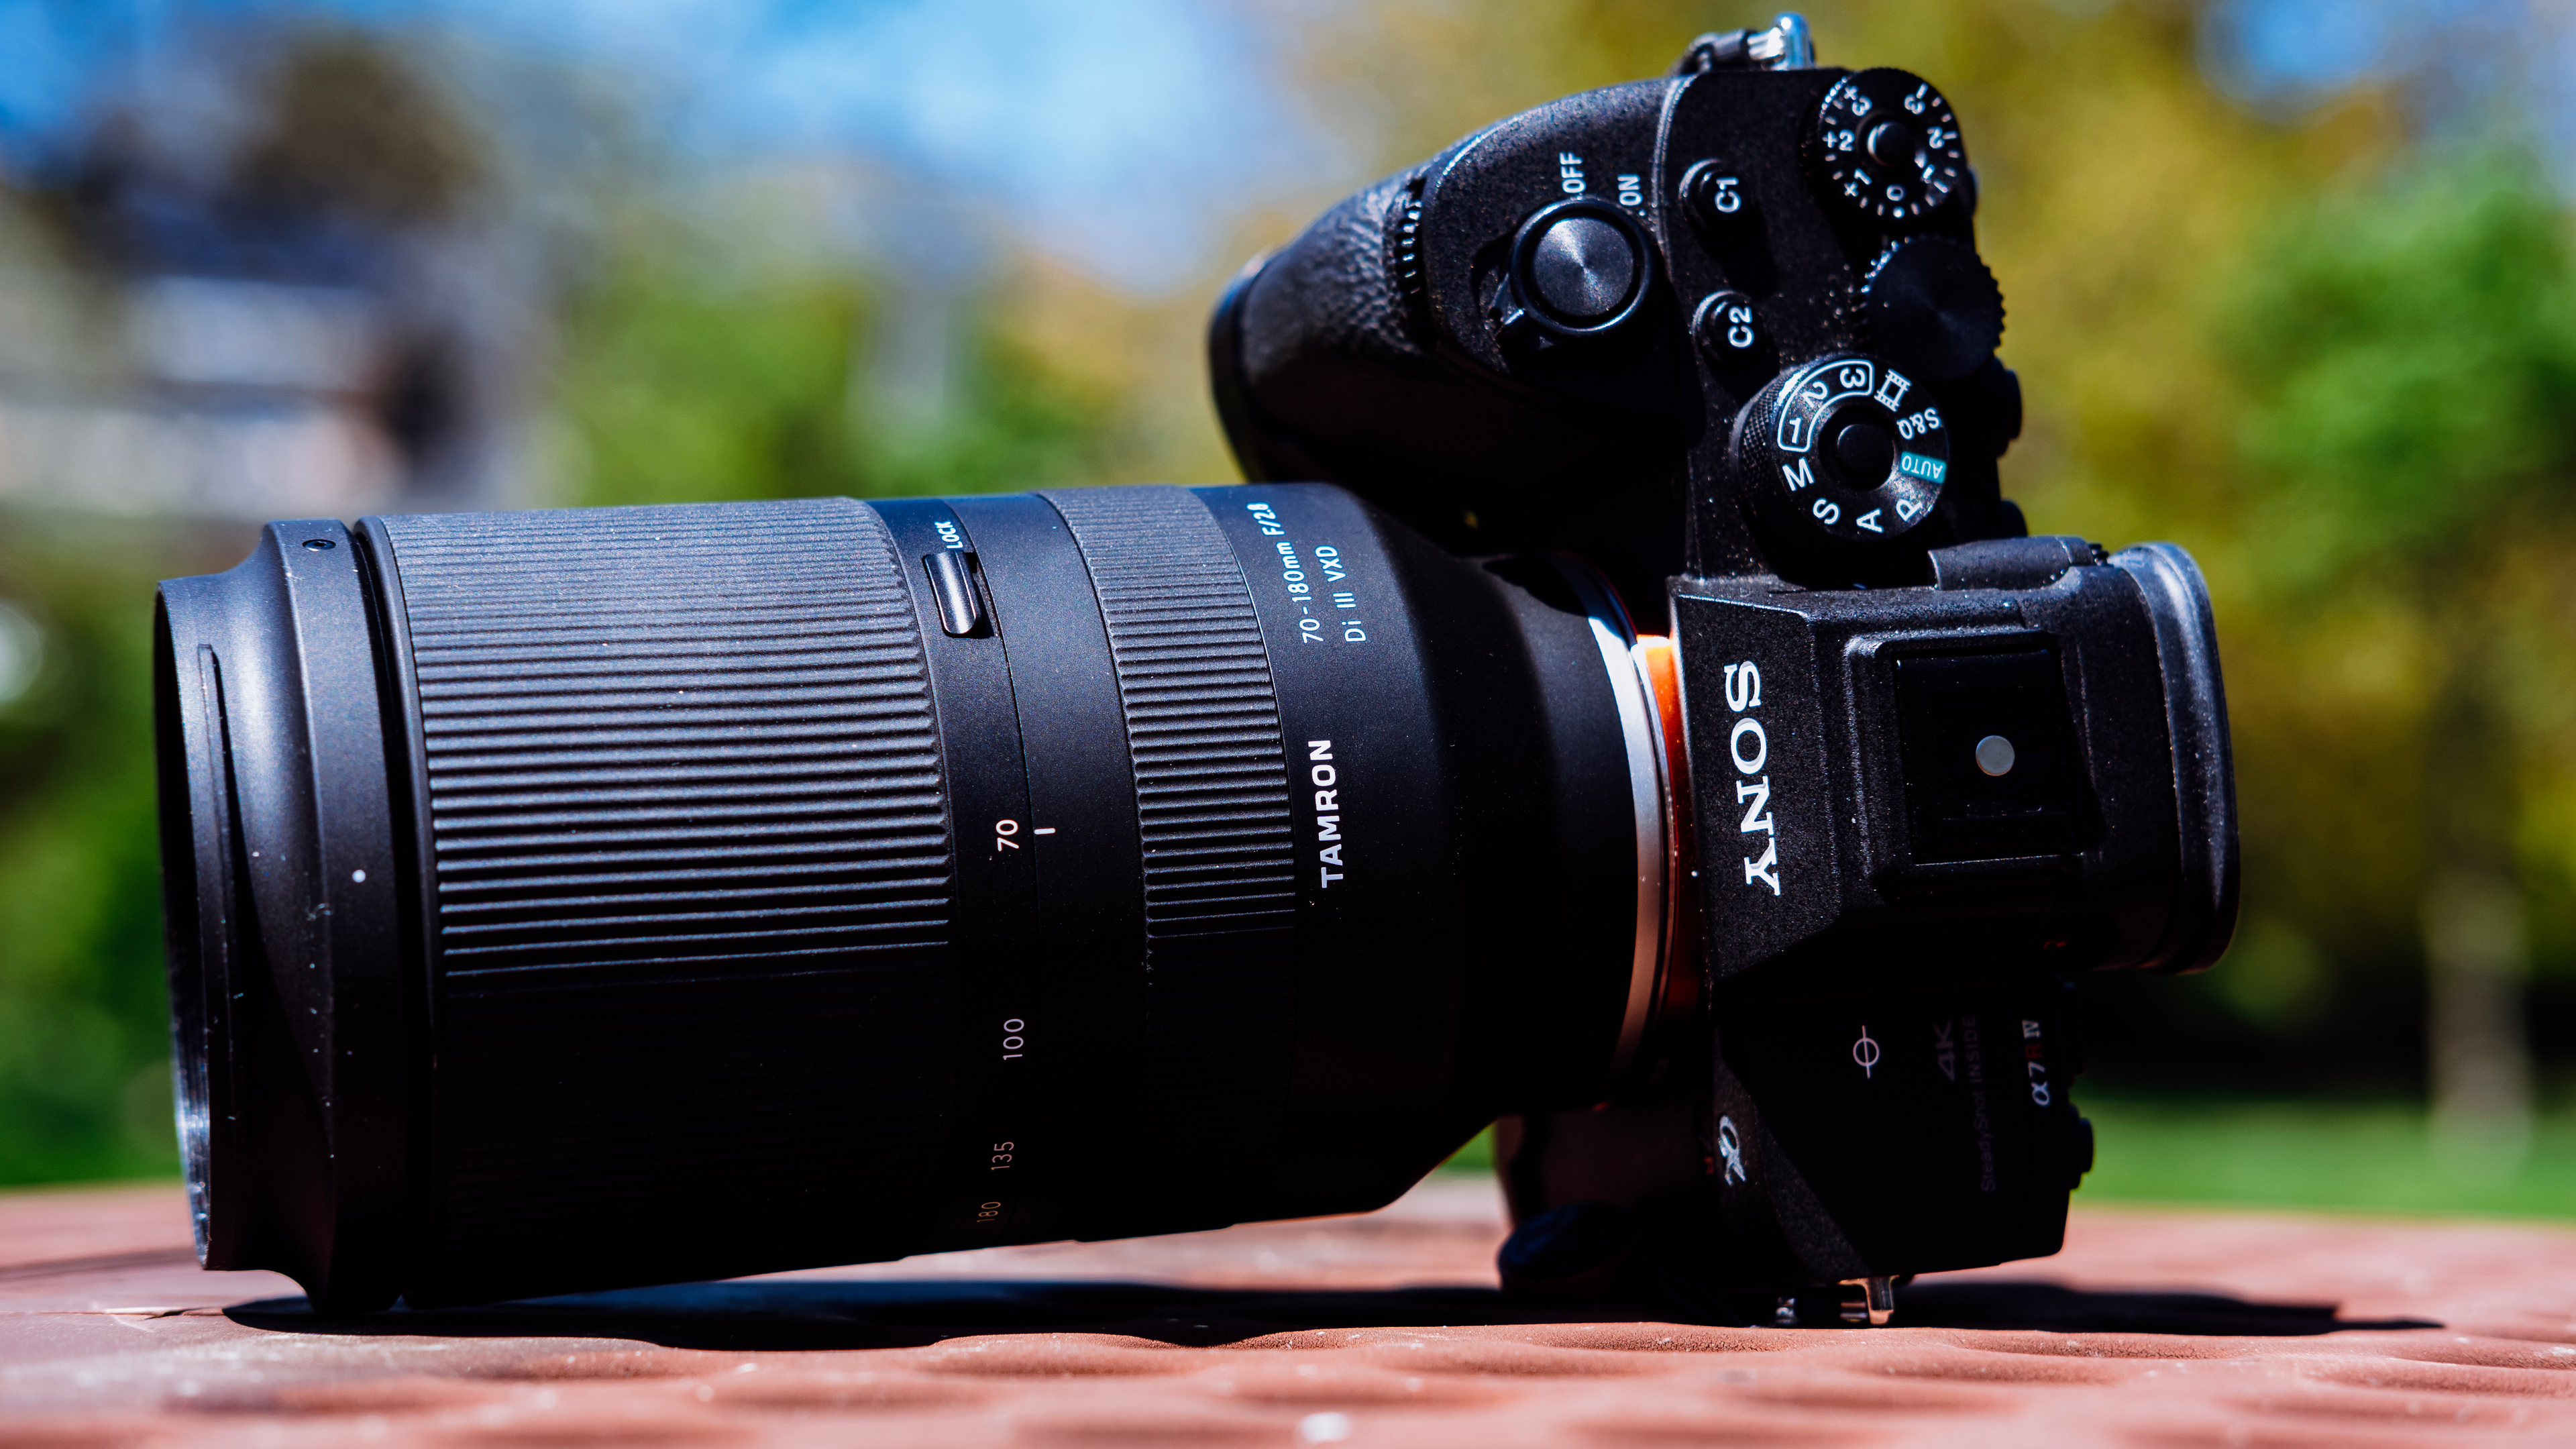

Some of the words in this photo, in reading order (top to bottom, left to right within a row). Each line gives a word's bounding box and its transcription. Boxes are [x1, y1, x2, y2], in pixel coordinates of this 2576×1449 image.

[1558, 152, 1587, 193] OFF
[1617, 174, 1644, 207] ON
[1714, 176, 1741, 213] C1
[1886, 184, 1904, 202] 0
[1727, 306, 1754, 349] C2
[1797, 380, 1829, 408] 2
[1839, 366, 1867, 389] 3
[1788, 415, 1803, 445] 1
[1896, 407, 1942, 440] S&Q
[1782, 456, 1815, 492] M
[1901, 455, 1943, 479] AUTO
[1812, 497, 1841, 525] S
[1856, 507, 1884, 534] A
[1895, 494, 1925, 522] P
[934, 520, 964, 549] LOCK
[1314, 545, 1346, 582] VXD
[1341, 619, 1366, 642] Di
[1723, 660, 1782, 897] SONY
[1307, 739, 1344, 889] TAMRON
[995, 819, 1020, 852] 70
[1002, 1018, 1024, 1061] 100
[1933, 1018, 1956, 1082] 4K
[1962, 1014, 1983, 1084] INSIDE
[990, 1141, 1014, 1171] 135
[1972, 1089, 1997, 1193] SteadyShot
[975, 1201, 1002, 1222] 180
